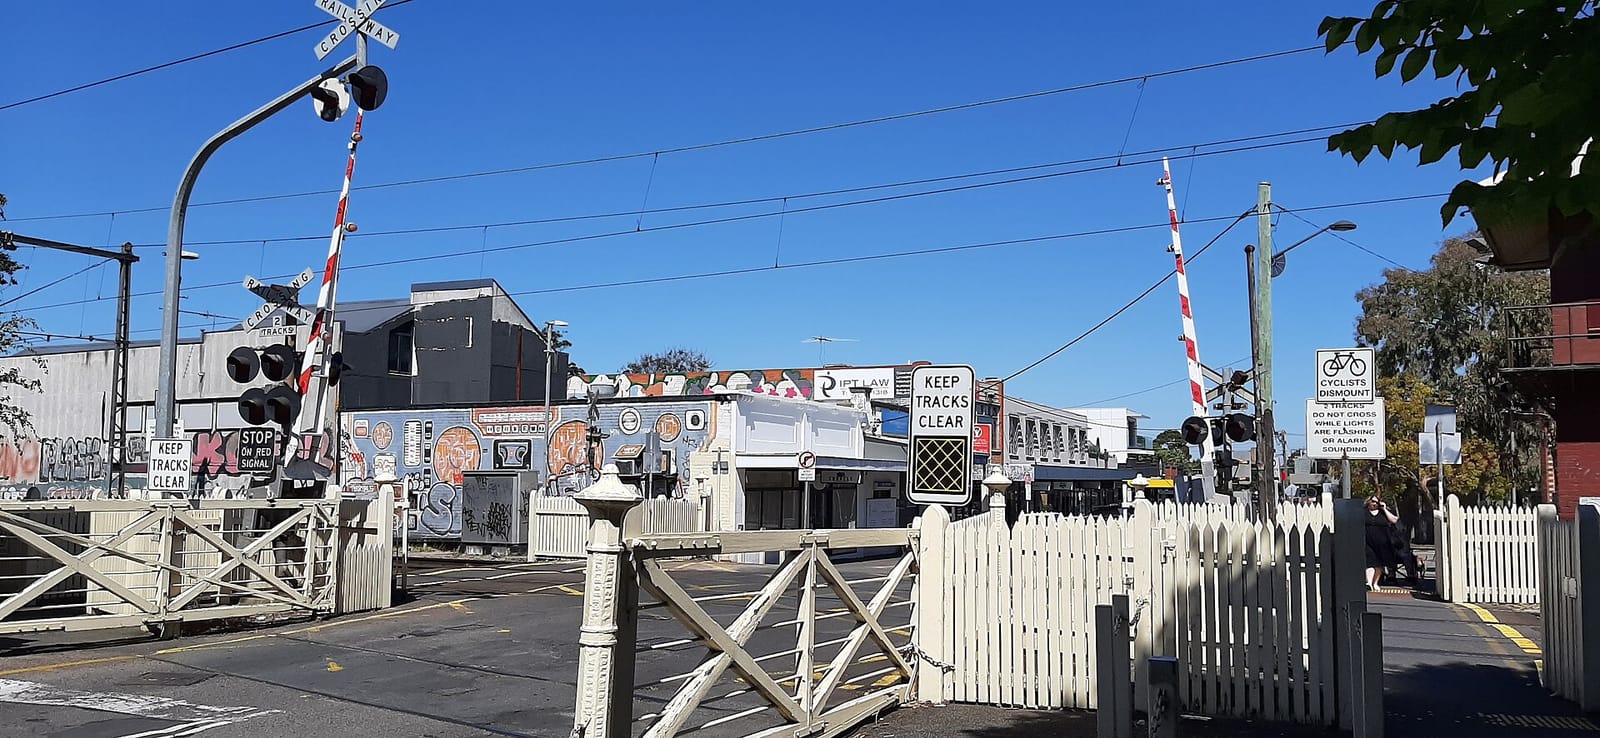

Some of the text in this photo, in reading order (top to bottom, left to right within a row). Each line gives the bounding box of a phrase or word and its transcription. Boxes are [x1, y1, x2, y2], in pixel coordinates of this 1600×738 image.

[274, 317, 281, 326] 2
[862, 379, 890, 387] LAW
[925, 376, 960, 388] KEEP
[1320, 379, 1367, 387] CYCLISTS
[1319, 389, 1371, 397] DISMOUNT
[915, 396, 969, 408] TRACKS
[919, 415, 964, 428] CLEAR
[241, 431, 273, 445] STOP
[158, 443, 183, 455] KEEP
[241, 447, 272, 457] ON RED
[152, 459, 188, 471] TRACKS
[241, 459, 270, 468] SIGNAL
[153, 476, 185, 489] CLEAR
